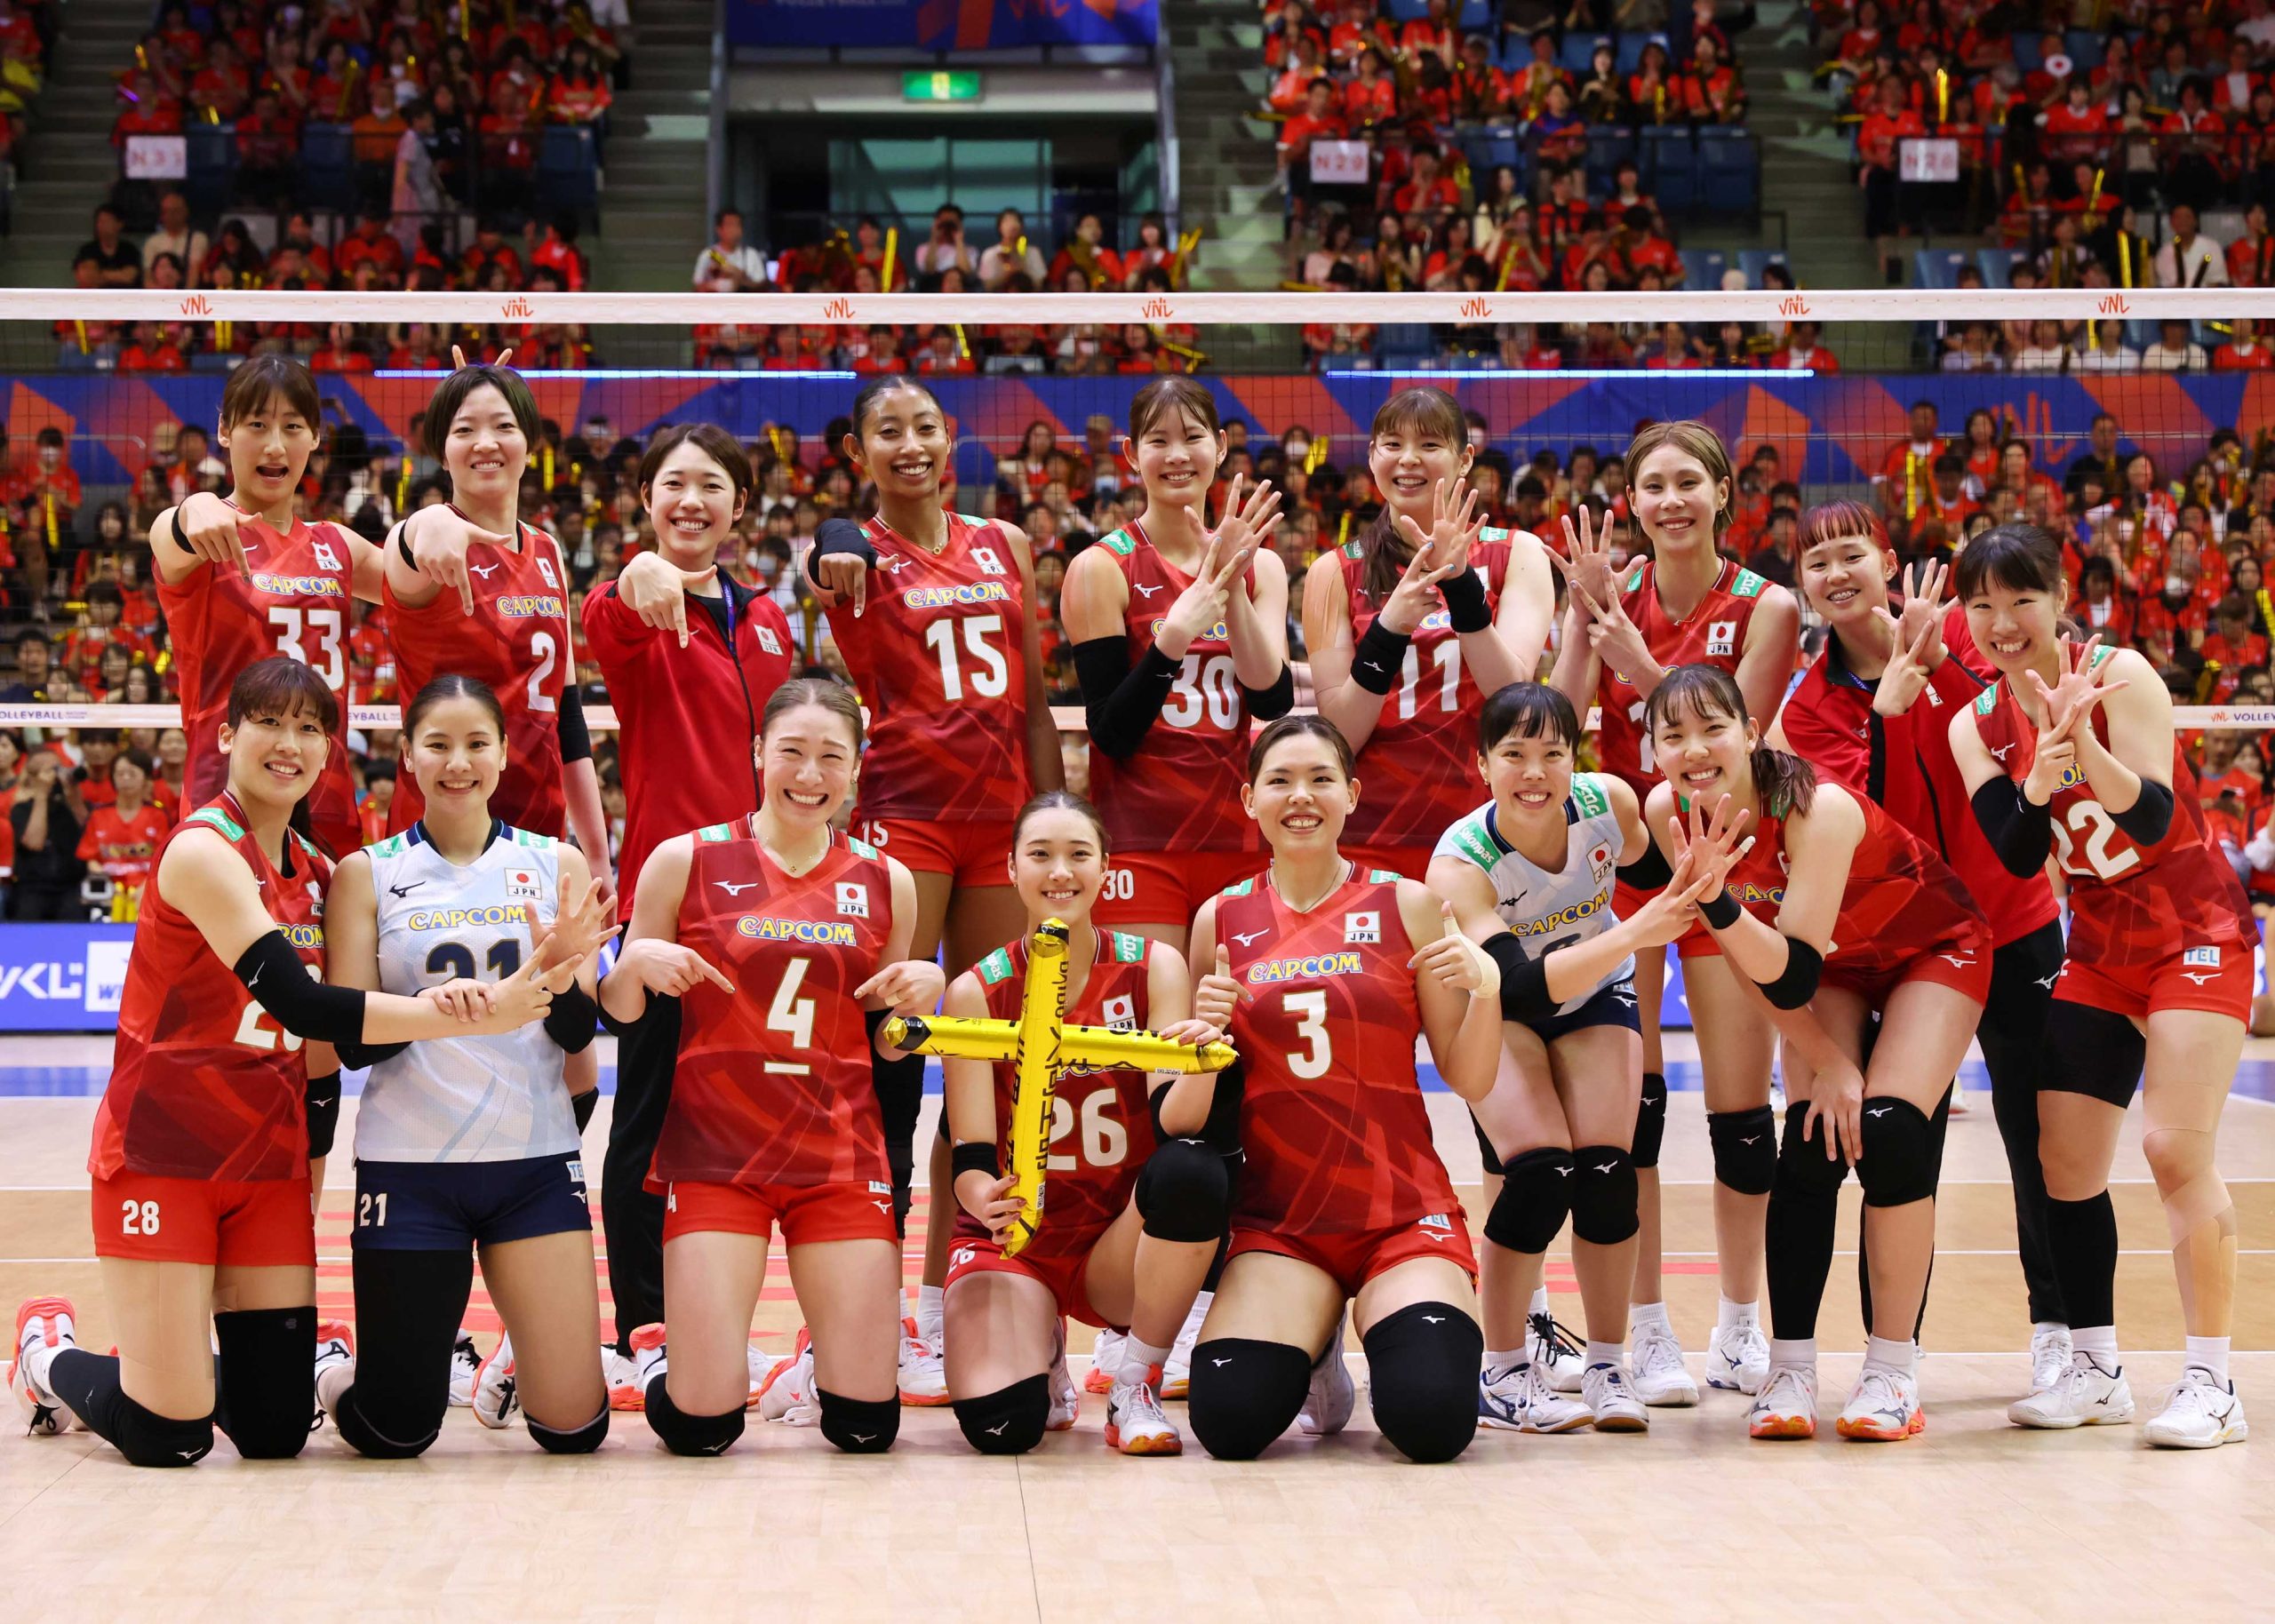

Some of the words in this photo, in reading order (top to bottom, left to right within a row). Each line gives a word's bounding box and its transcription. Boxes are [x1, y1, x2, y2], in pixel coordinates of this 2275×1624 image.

[180, 294, 212, 315] VNL
[502, 297, 534, 318] VNL
[824, 298, 856, 319] VNL
[1142, 298, 1173, 318] VNL
[1460, 297, 1492, 318] VNL
[1778, 295, 1810, 316] VNL
[2098, 293, 2130, 314] VNL
[252, 573, 345, 598] CAPCOM
[903, 580, 1010, 609] CAPCOM
[497, 595, 565, 619] CAPCOM
[268, 607, 345, 691] 33
[926, 615, 1008, 701] 15
[1711, 645, 1728, 654] JPN
[527, 632, 556, 712] 2
[1398, 639, 1460, 720] 11
[1161, 654, 1240, 730] 30
[862, 820, 888, 847] 15
[1598, 861, 1612, 879] JPN
[1103, 870, 1134, 901] 30
[408, 905, 529, 932] CAPCOM
[842, 904, 864, 915] JPN
[1511, 887, 1609, 936] CAPCOM
[738, 916, 857, 946] CAPCOM
[1248, 952, 1362, 983] CAPCOM
[2186, 948, 2218, 964] TEL
[766, 957, 816, 1050] 4
[1282, 989, 1332, 1079] 3
[1047, 1087, 1128, 1171] 26
[122, 1199, 160, 1236] 28
[360, 1193, 387, 1228] 21
